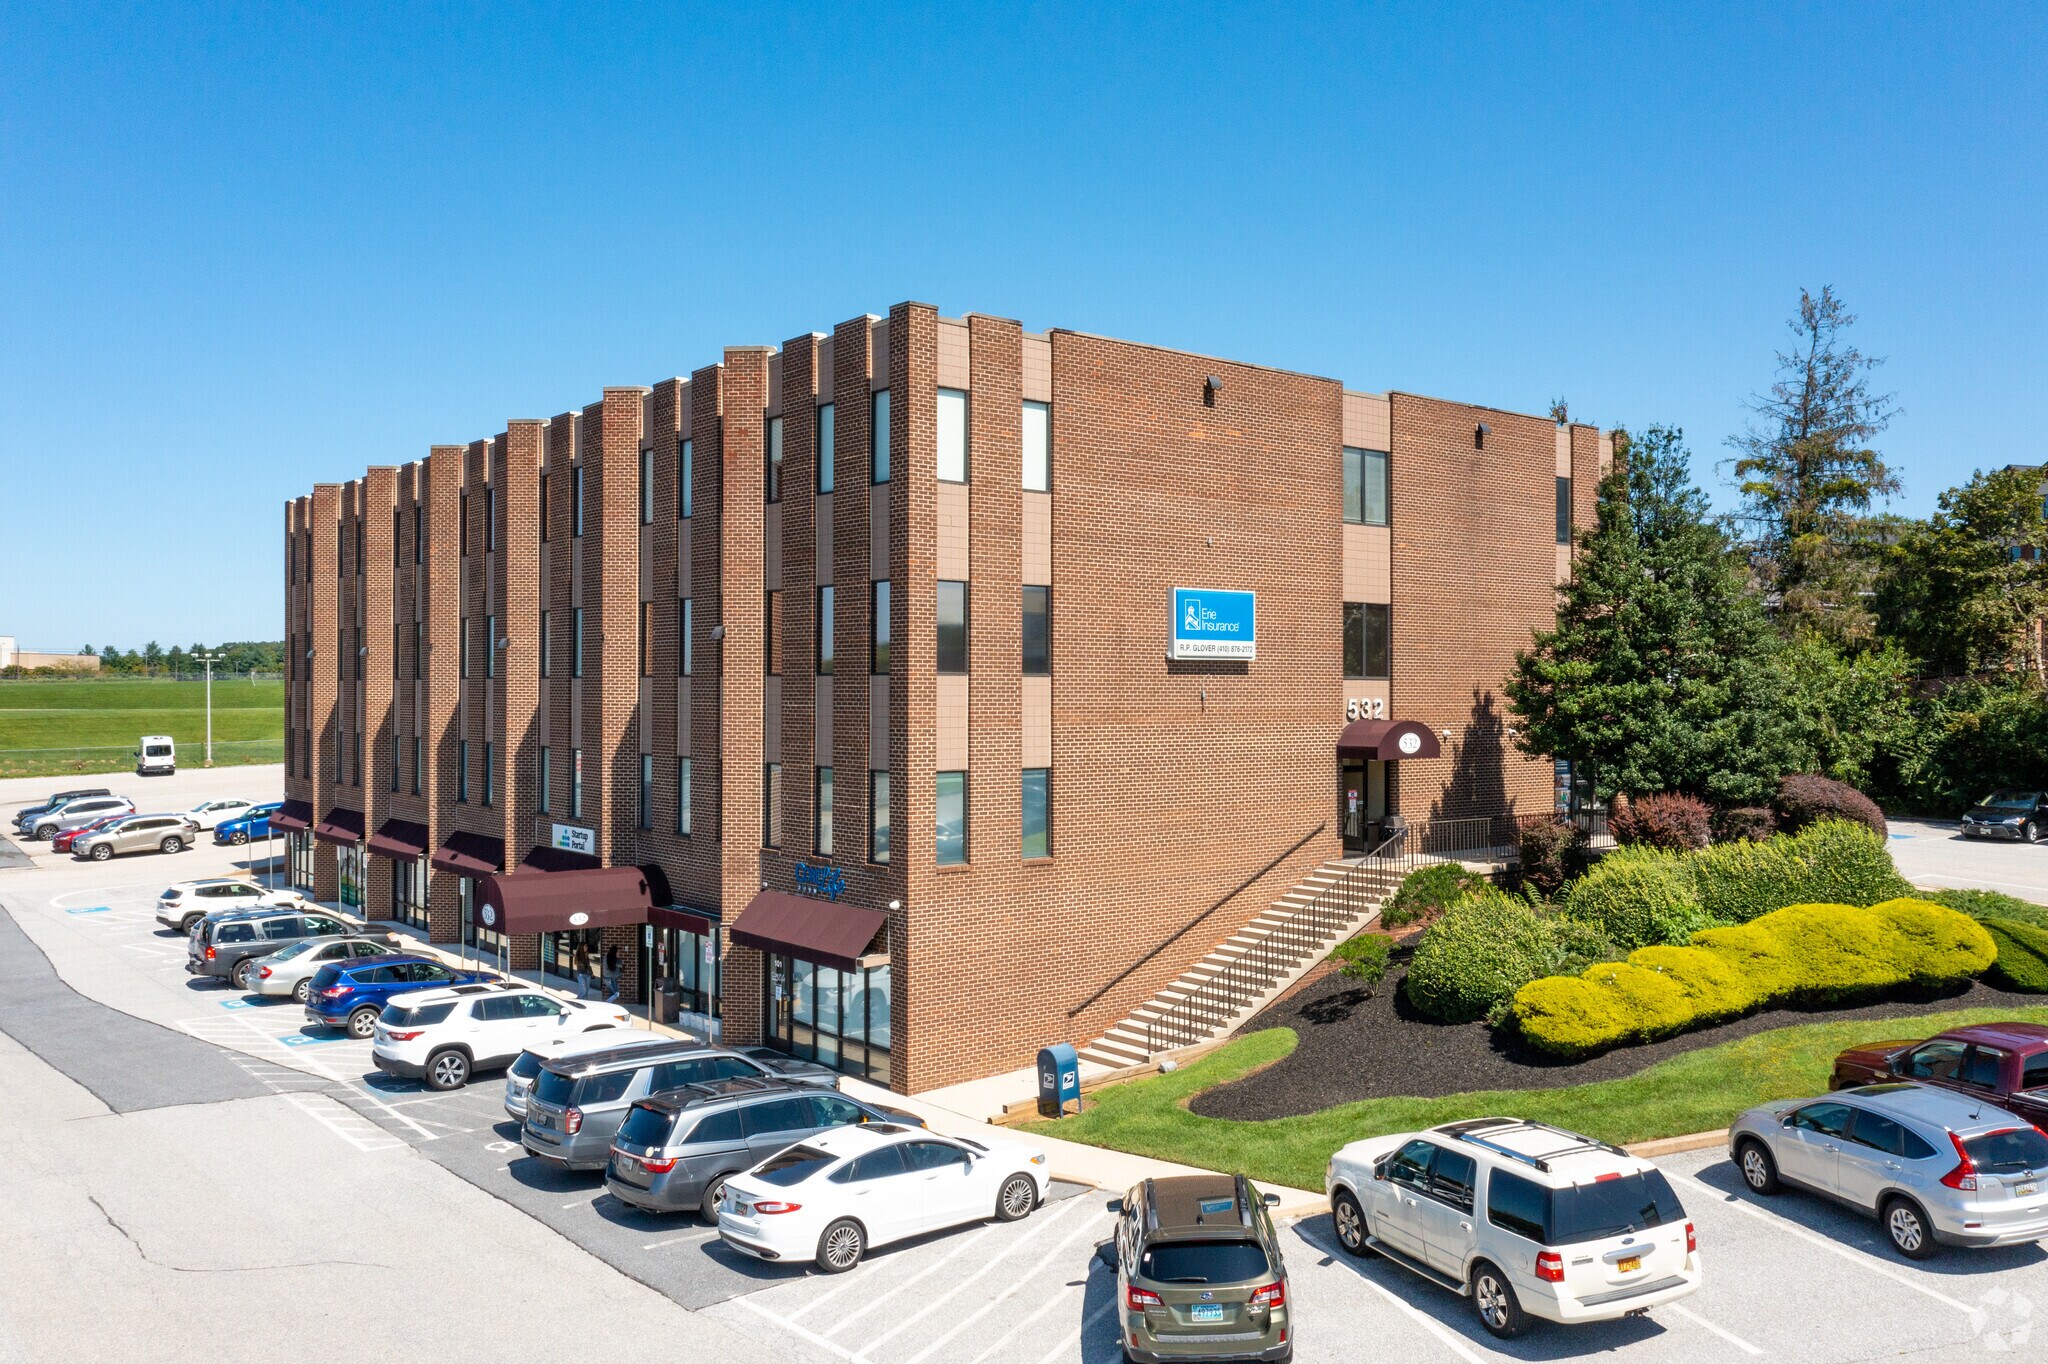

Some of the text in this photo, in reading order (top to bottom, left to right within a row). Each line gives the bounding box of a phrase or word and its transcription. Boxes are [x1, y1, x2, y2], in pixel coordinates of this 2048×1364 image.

[1201, 608, 1217, 620] Erie
[1201, 620, 1239, 632] Insurance
[1192, 644, 1216, 652] GLOVER
[1217, 645, 1230, 653] (410)
[1346, 698, 1384, 720] 532
[1402, 738, 1418, 749] 532
[571, 829, 588, 842] Startup
[571, 840, 586, 851] Portal
